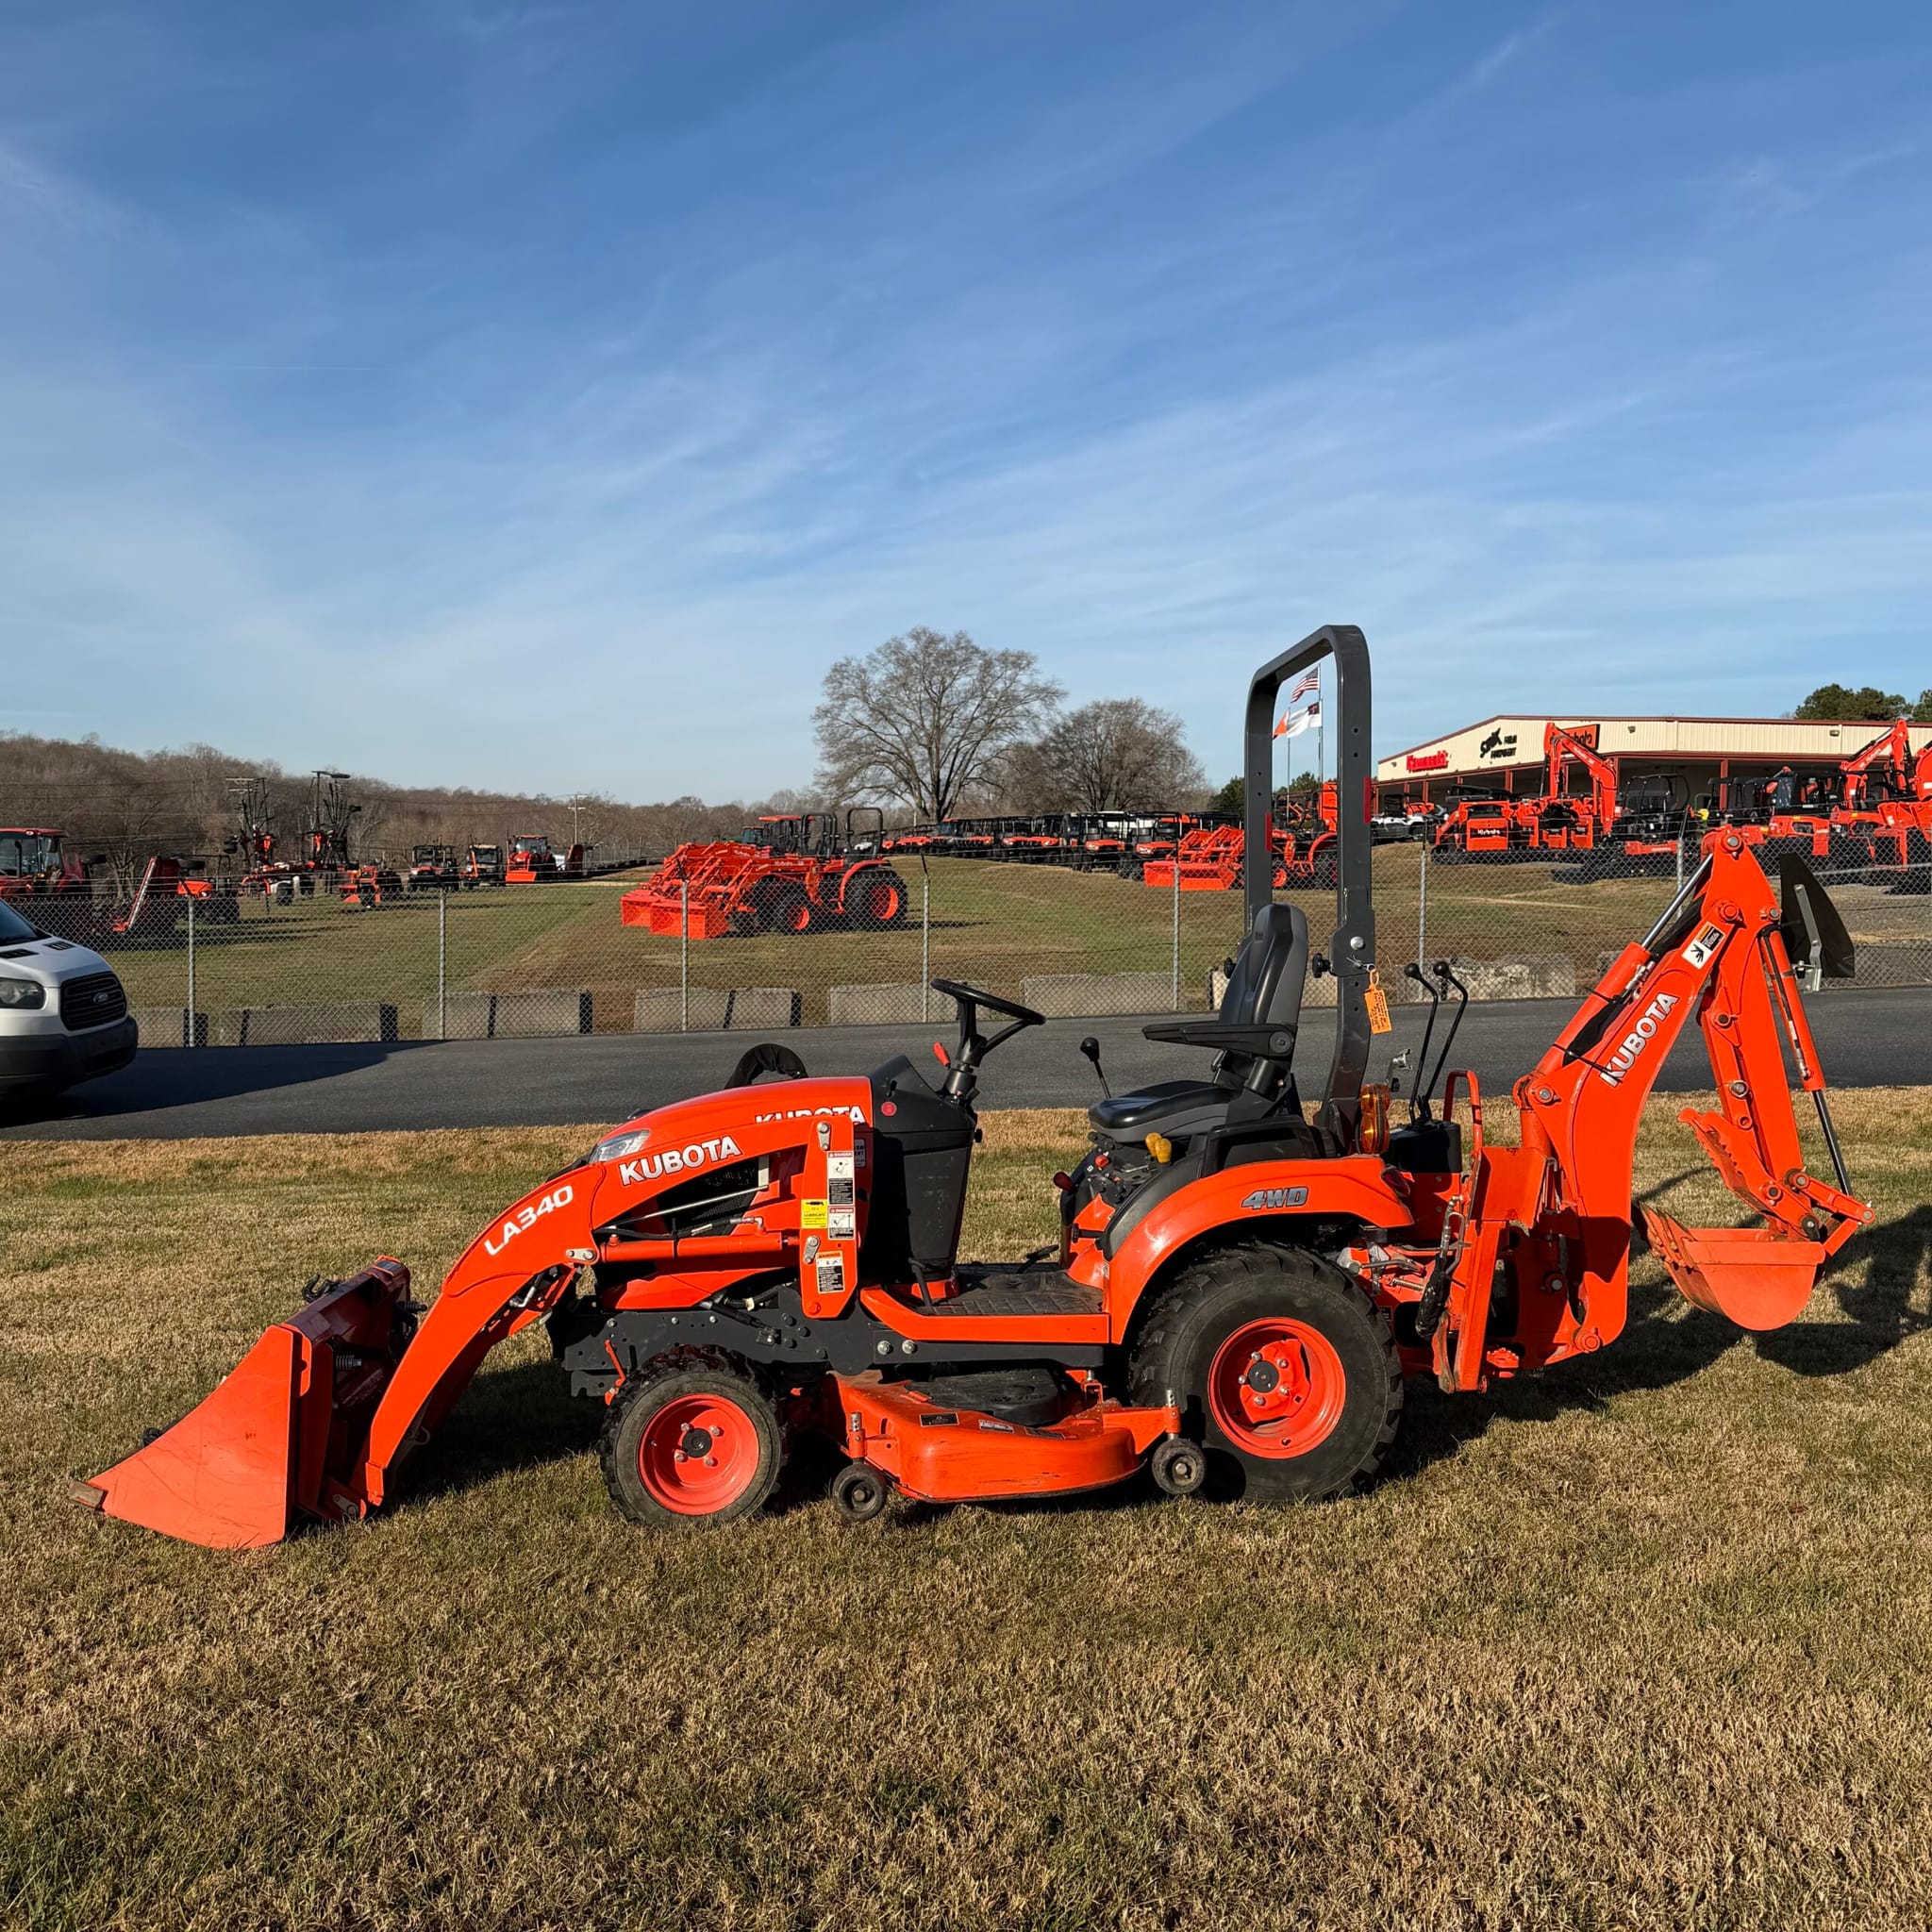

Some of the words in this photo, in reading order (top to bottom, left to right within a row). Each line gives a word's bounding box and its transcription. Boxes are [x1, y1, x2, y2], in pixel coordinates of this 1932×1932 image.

[1599, 992, 1679, 1088] KUBOTA
[619, 1135, 742, 1186] KUBOTA
[484, 1185, 574, 1256] LA340
[1241, 1186, 1309, 1210] 4WD
